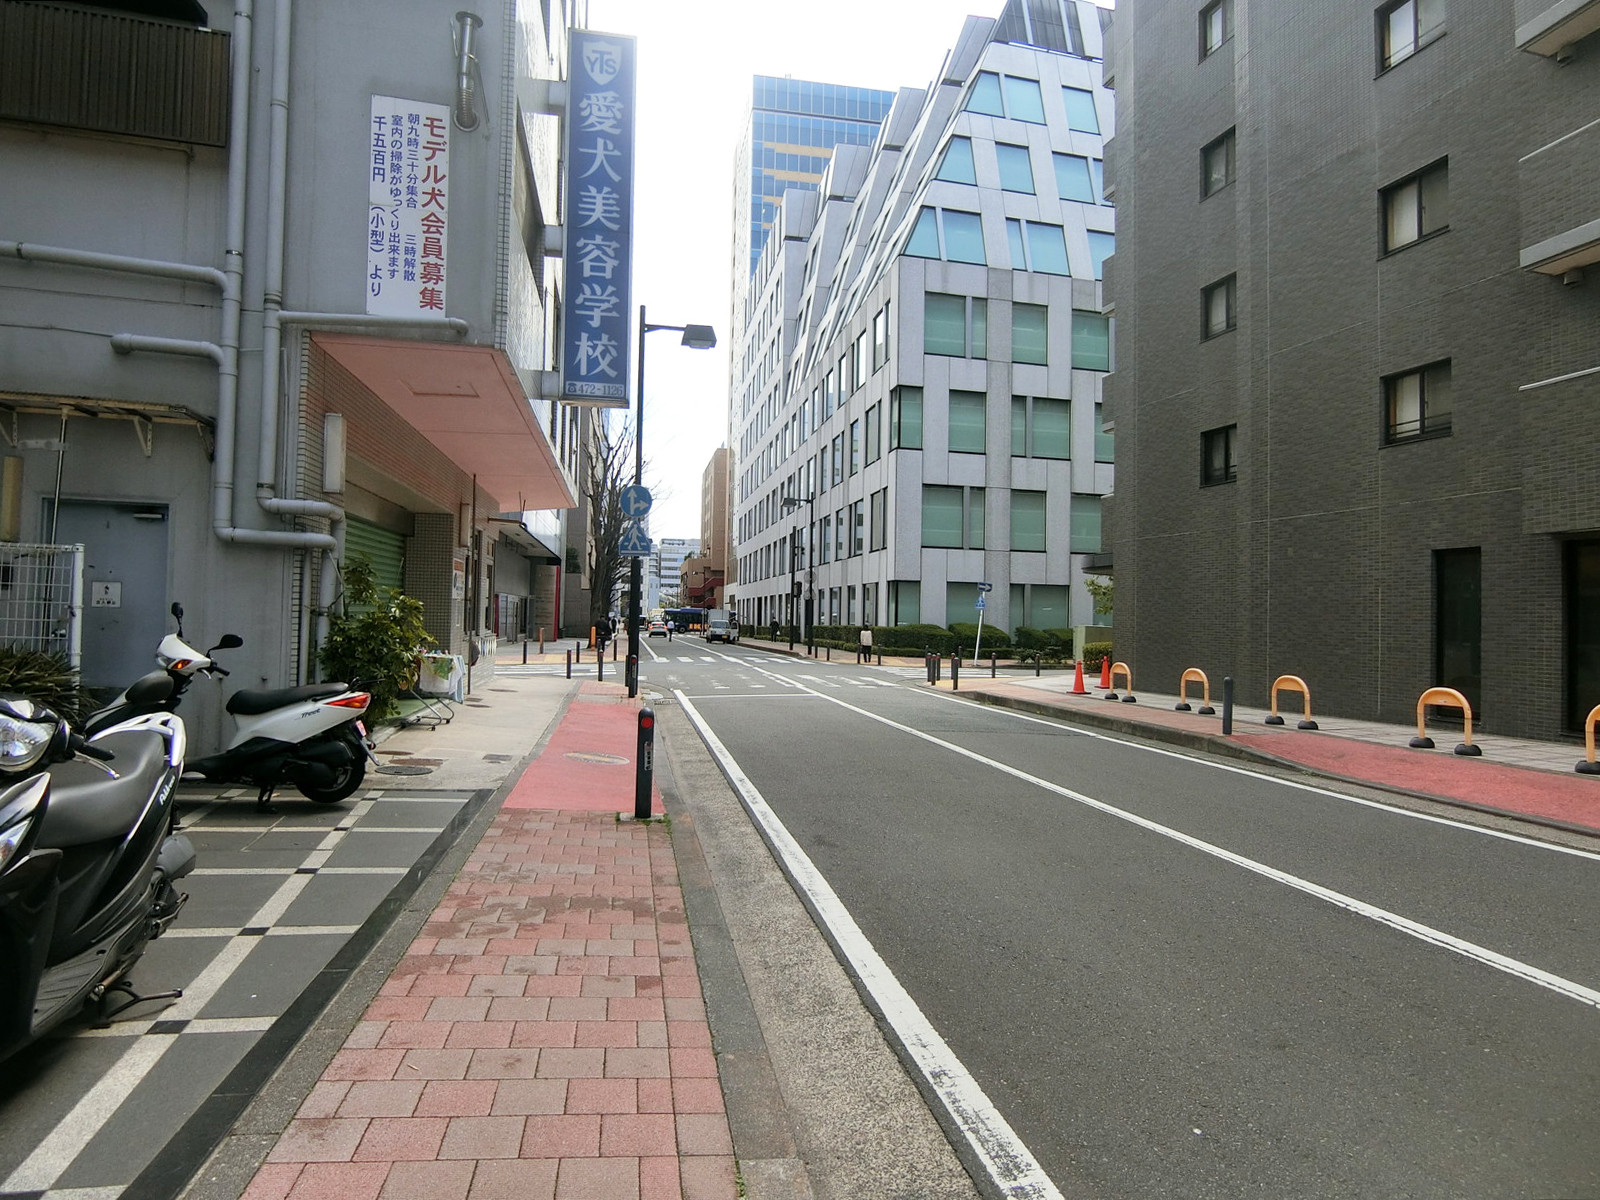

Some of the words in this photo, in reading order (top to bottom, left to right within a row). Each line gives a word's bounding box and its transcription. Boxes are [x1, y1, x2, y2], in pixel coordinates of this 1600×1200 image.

[372, 115, 388, 183] 千五百円
[387, 114, 404, 280] 室内の掃除がゆっくり出来ます
[405, 113, 420, 209] 朝九時三十分集合
[403, 233, 417, 282] 三時解散
[419, 116, 448, 311] モデル犬会員募集
[573, 90, 624, 379] 愛犬美容学校
[369, 264, 383, 297] より
